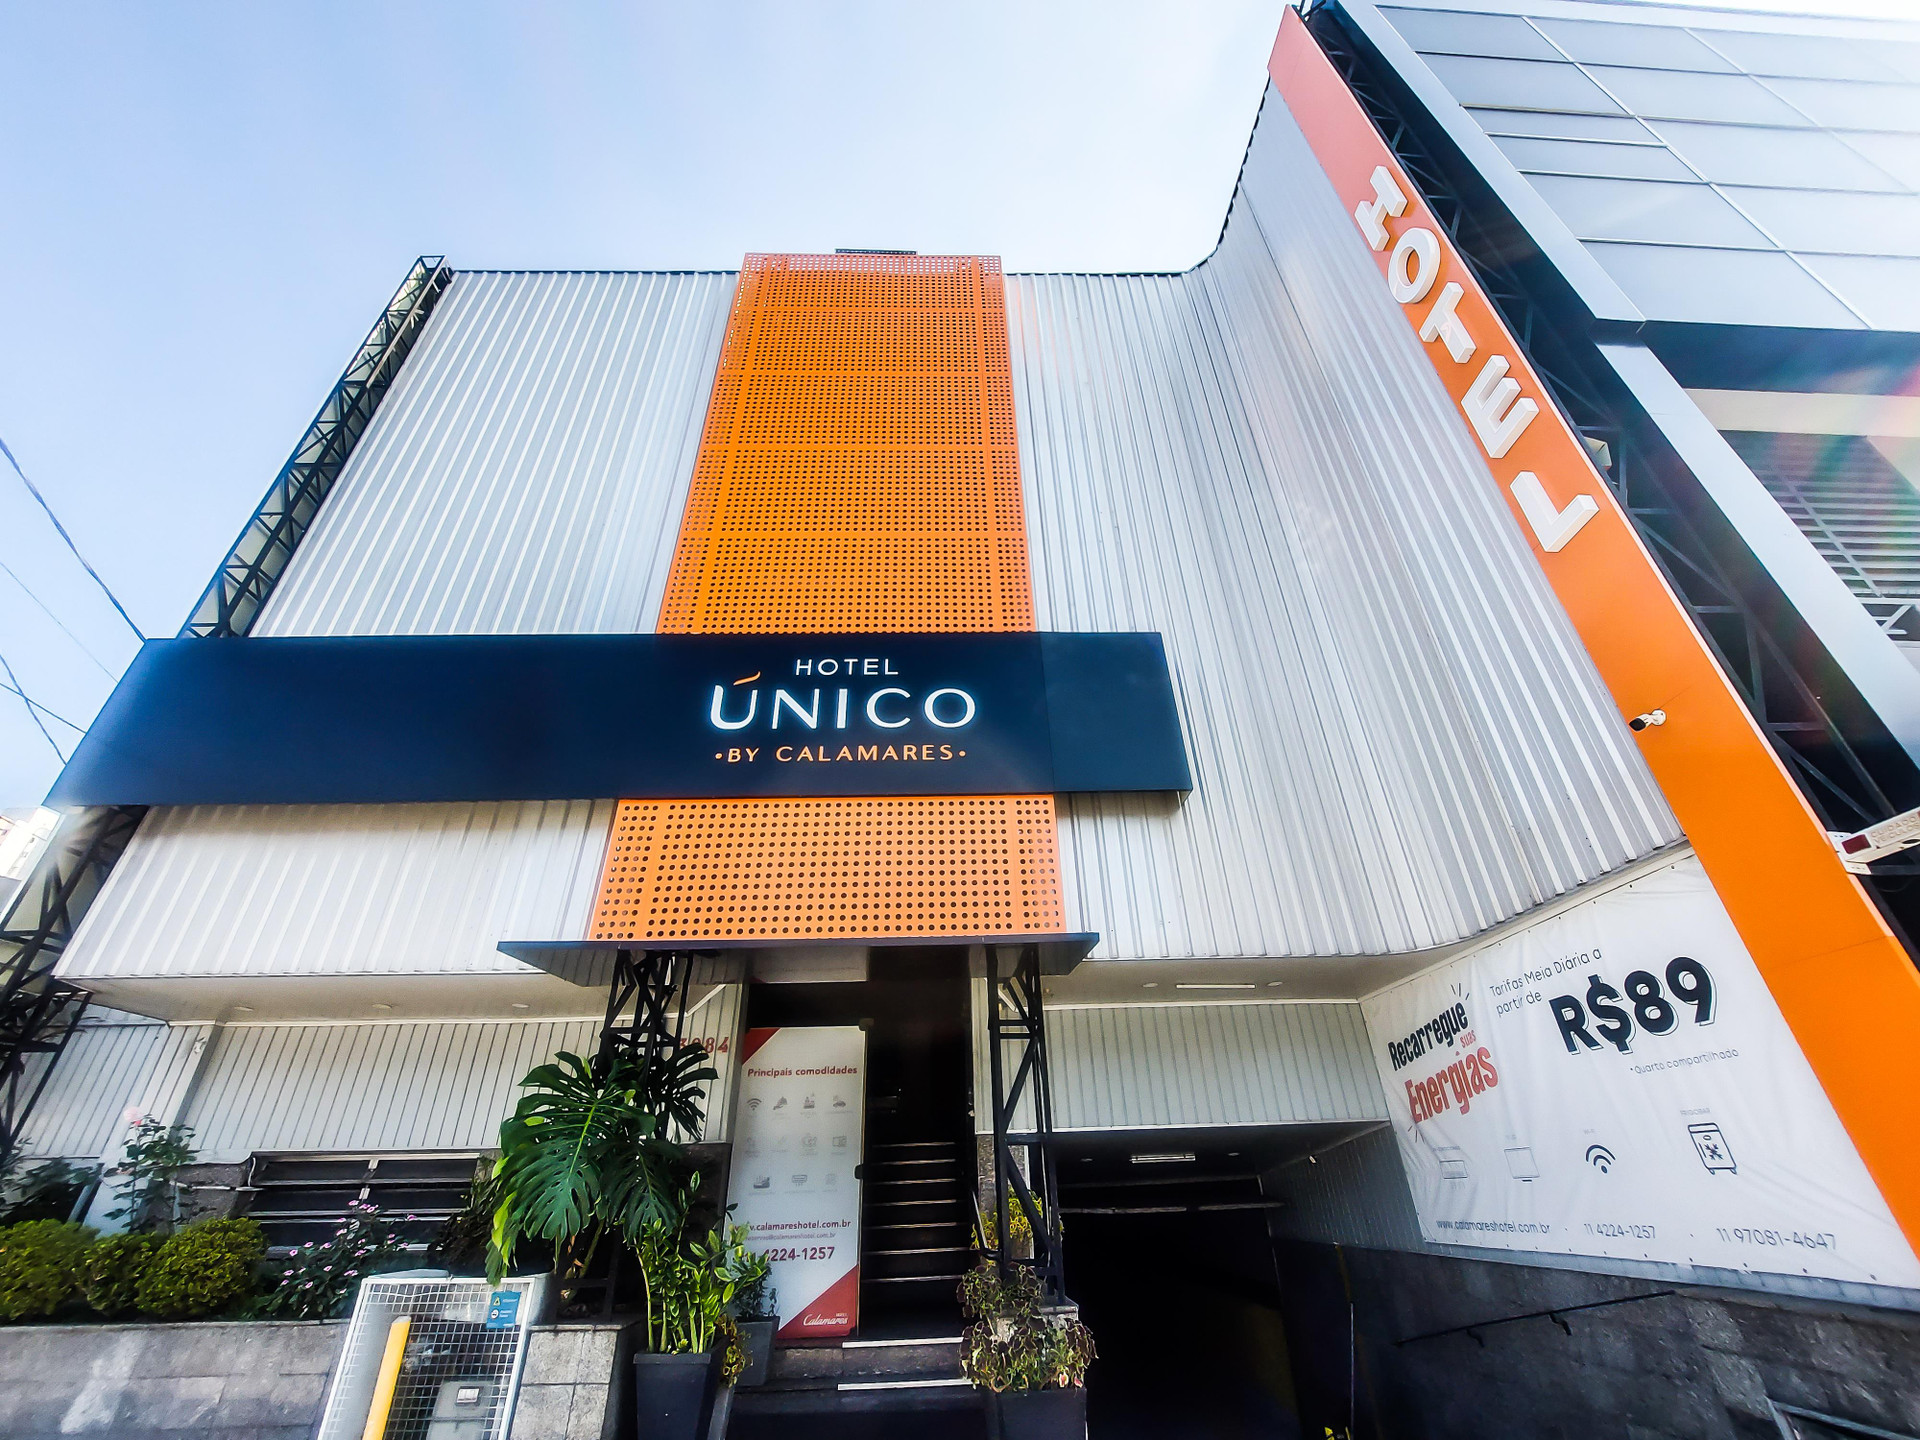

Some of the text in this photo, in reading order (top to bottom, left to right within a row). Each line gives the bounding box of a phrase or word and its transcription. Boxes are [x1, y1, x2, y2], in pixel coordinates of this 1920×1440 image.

[1354, 166, 1600, 552] HOTEL
[796, 658, 899, 676] HOTEL
[710, 671, 976, 730] ÚNICO
[727, 744, 954, 762] BY CALAMARES
[1490, 948, 1602, 998] Tarifas Meia Diária a
[1496, 990, 1543, 1018] partir de
[1548, 956, 1718, 1056] R$89
[1387, 1002, 1469, 1072] Recarregue
[1459, 1029, 1477, 1049] suas
[747, 1065, 858, 1079] Principais comodidades
[1666, 1048, 1739, 1068] compartilhado
[1404, 1046, 1499, 1124] Energias
[1436, 1220, 1551, 1234] www.calamareshotel.com.br
[1596, 1224, 1657, 1240] 4224-1257
[1716, 1228, 1732, 1243] 11
[1733, 1228, 1838, 1250] 97081-4647
[803, 1313, 849, 1326] Calamares
